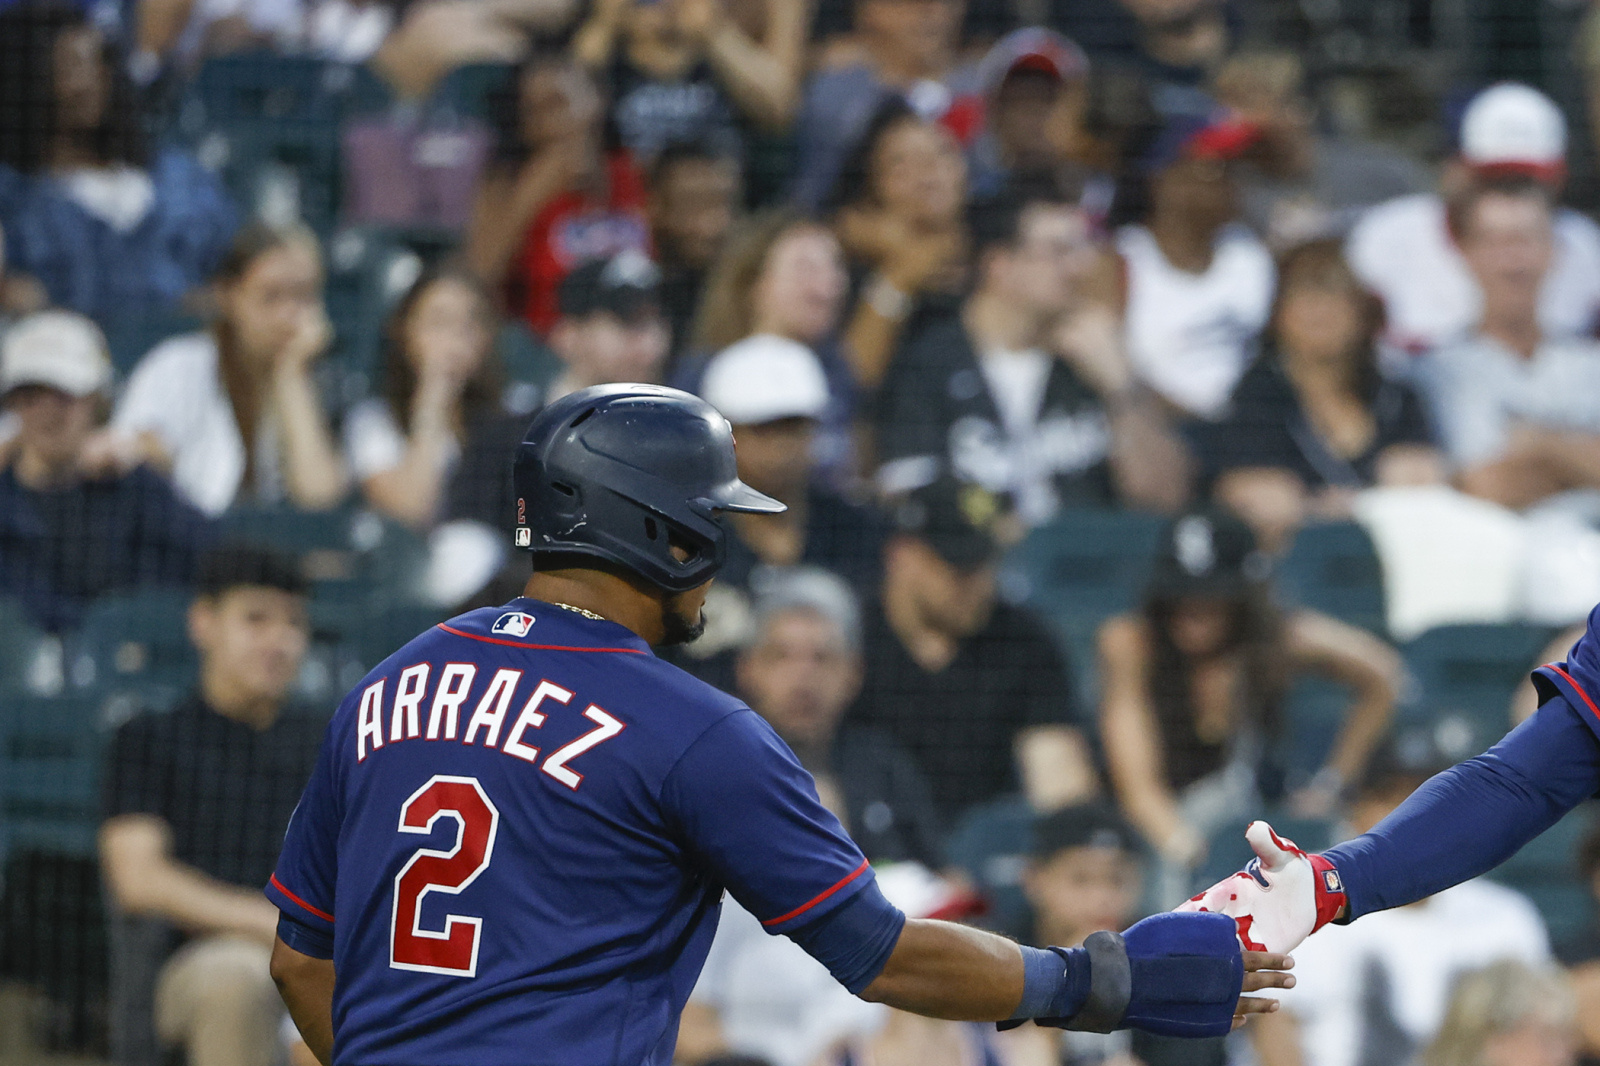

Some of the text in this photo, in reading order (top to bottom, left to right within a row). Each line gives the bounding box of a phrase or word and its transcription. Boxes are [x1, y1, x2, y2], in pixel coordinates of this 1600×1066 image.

[517, 497, 526, 524] 2
[357, 661, 627, 791] ARRAEZ
[389, 774, 499, 978] 2
